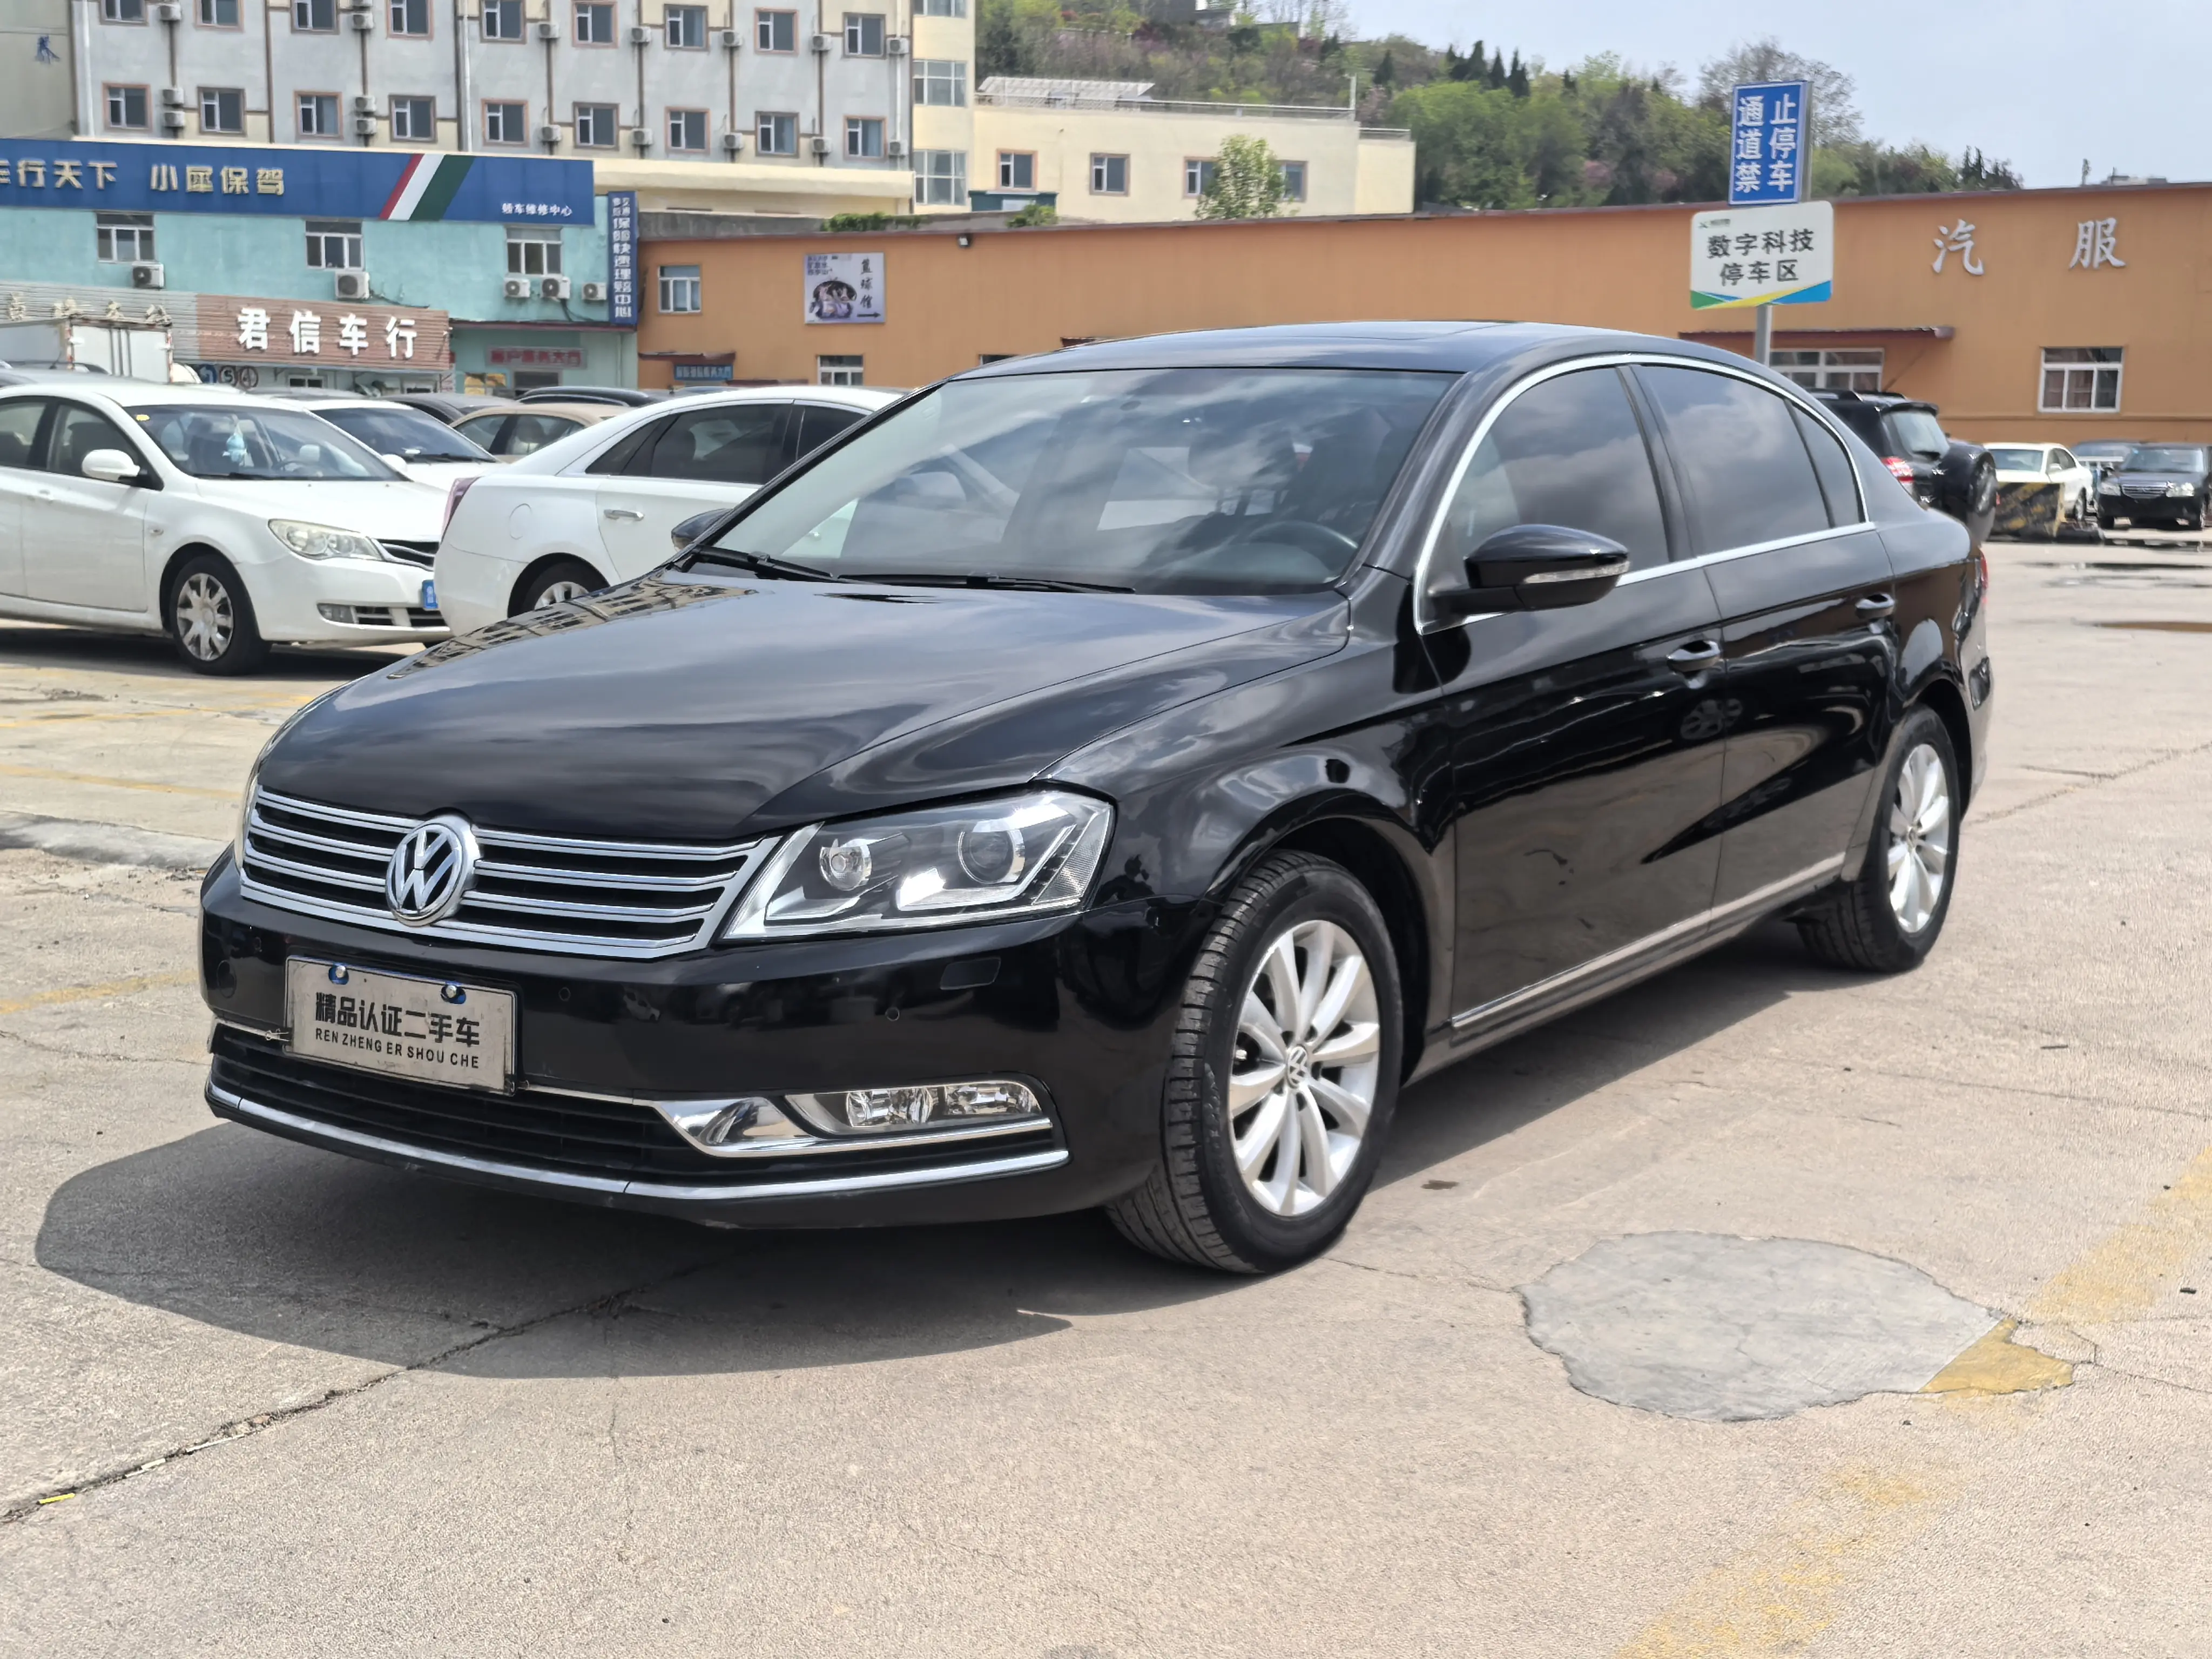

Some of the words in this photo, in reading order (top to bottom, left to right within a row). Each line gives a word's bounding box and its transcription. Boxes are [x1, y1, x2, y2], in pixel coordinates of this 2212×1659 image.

[1735, 96, 1764, 193] 通道禁
[1767, 93, 1797, 192] 止停车
[1707, 228, 1815, 258] 数字科技
[1719, 259, 1799, 287] 停车区
[237, 307, 418, 359] 君信车行
[315, 992, 480, 1048] 精品认证二手车
[315, 1028, 338, 1044] REN
[342, 1034, 382, 1053] ZHENG
[387, 1042, 402, 1057] ER
[407, 1046, 444, 1063] SHOU
[450, 1053, 479, 1069] CHE
